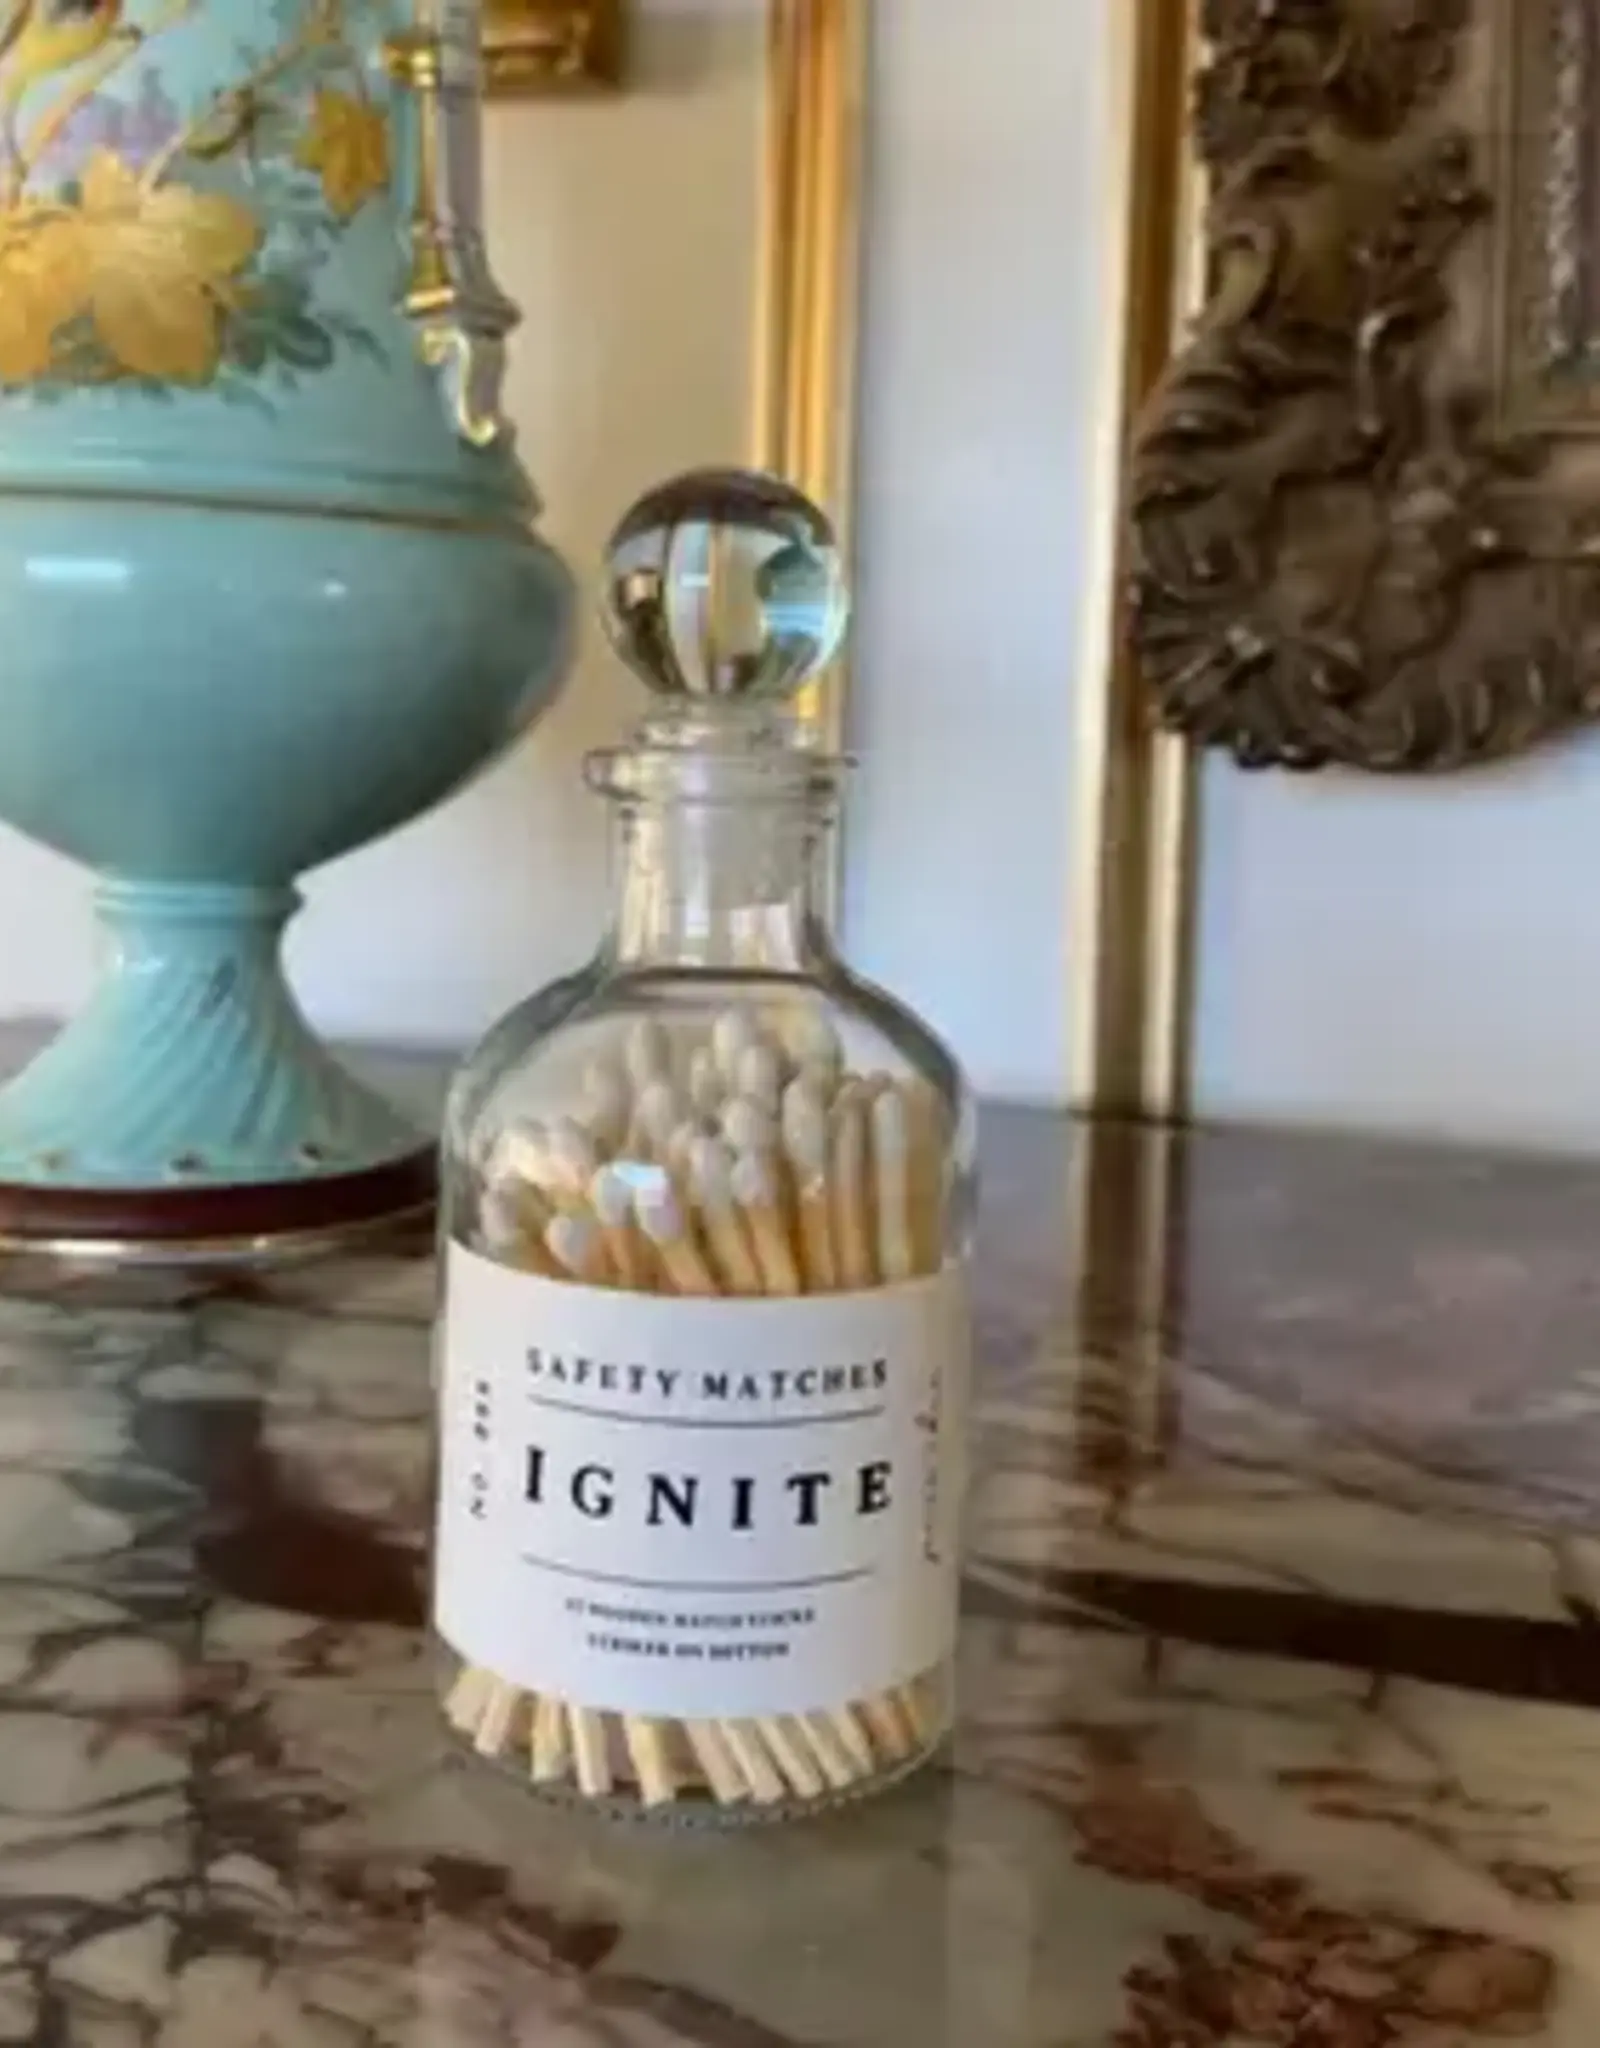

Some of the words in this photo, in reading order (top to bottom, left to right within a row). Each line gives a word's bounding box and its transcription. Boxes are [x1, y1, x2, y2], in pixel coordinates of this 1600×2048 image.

[526, 1346, 681, 1398] SAFETY
[700, 1357, 888, 1401] MATCHES
[525, 1445, 893, 1530] IGNITE
